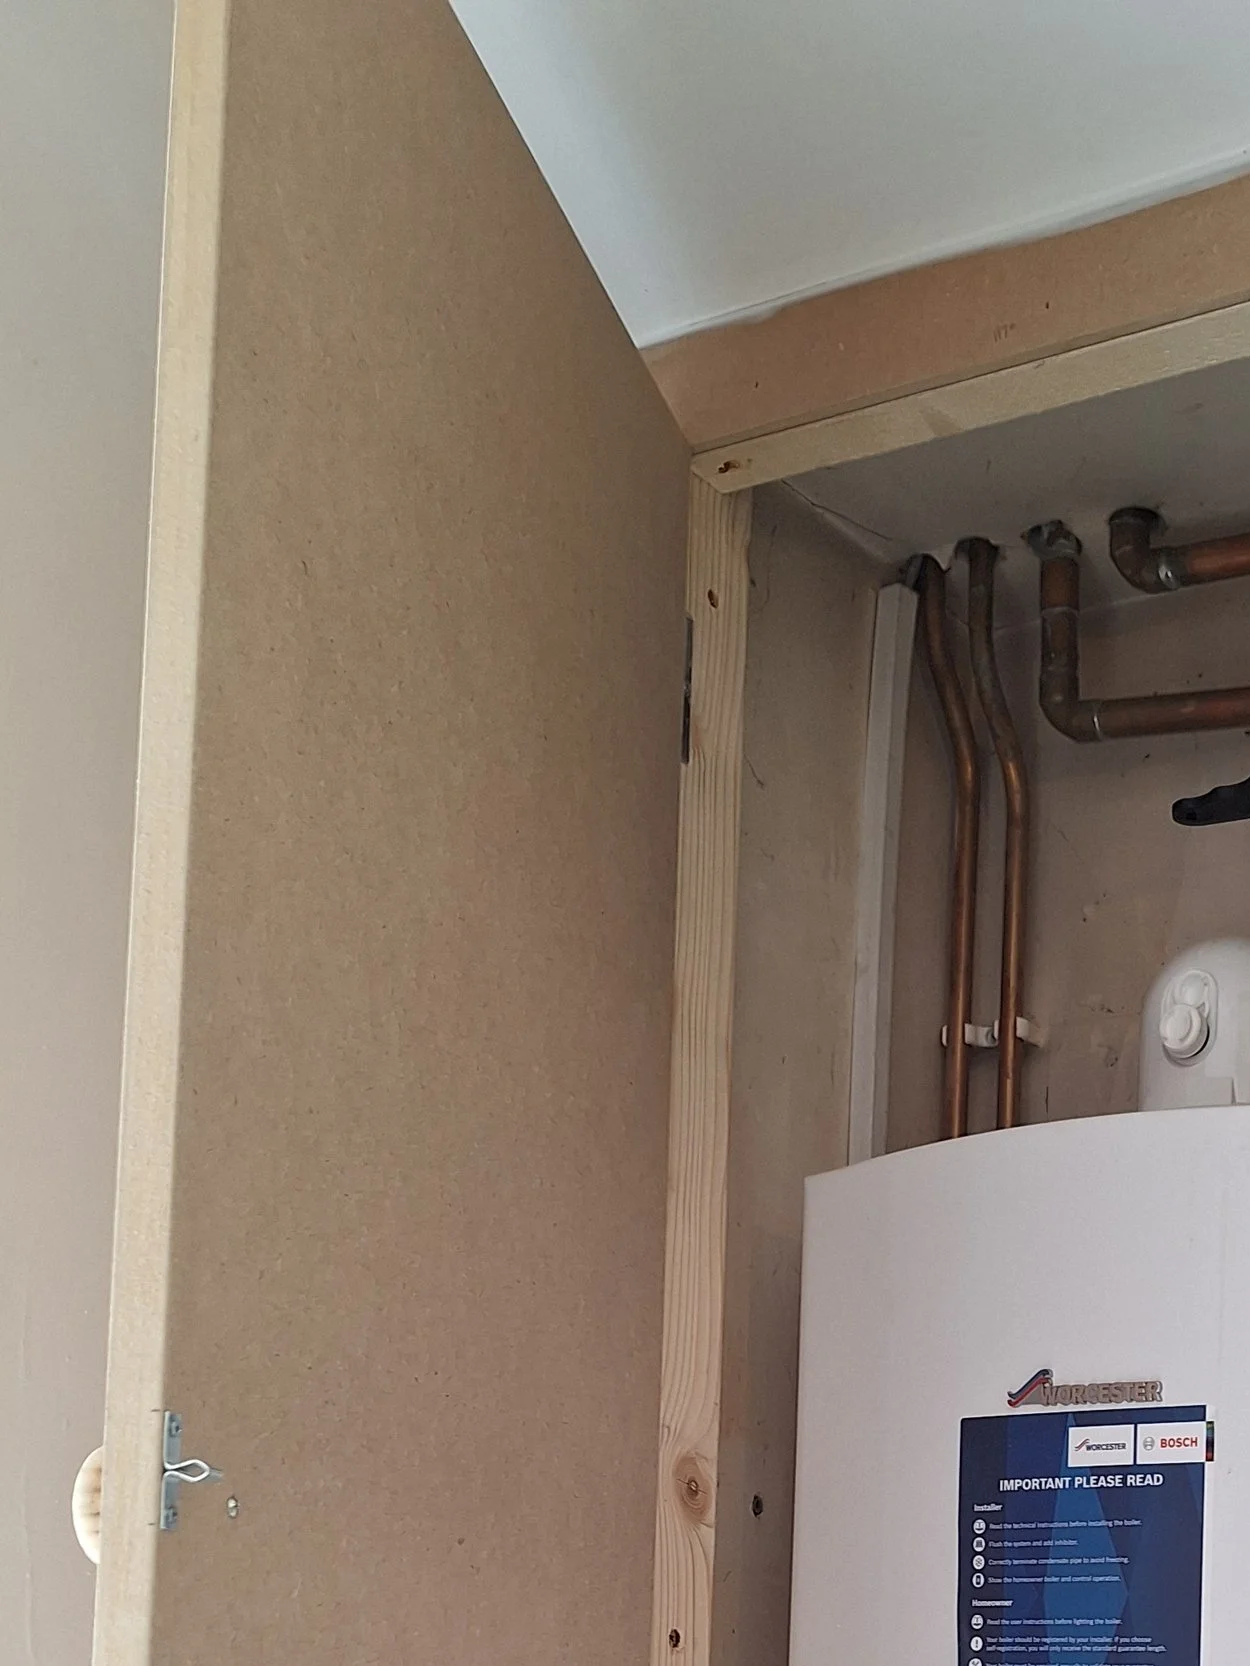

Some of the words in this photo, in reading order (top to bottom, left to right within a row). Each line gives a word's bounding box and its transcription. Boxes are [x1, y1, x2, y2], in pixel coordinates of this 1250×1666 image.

[1041, 1380, 1163, 1406] WORCESTER
[1085, 1442, 1127, 1452] WORCESTER
[1160, 1436, 1198, 1449] BOSCH
[999, 1477, 1071, 1492] IMPORTANT
[1074, 1475, 1123, 1489] PLEASE
[1126, 1474, 1164, 1487] READ
[973, 1503, 1003, 1512] Installer
[971, 1599, 1013, 1607] Homeowner
